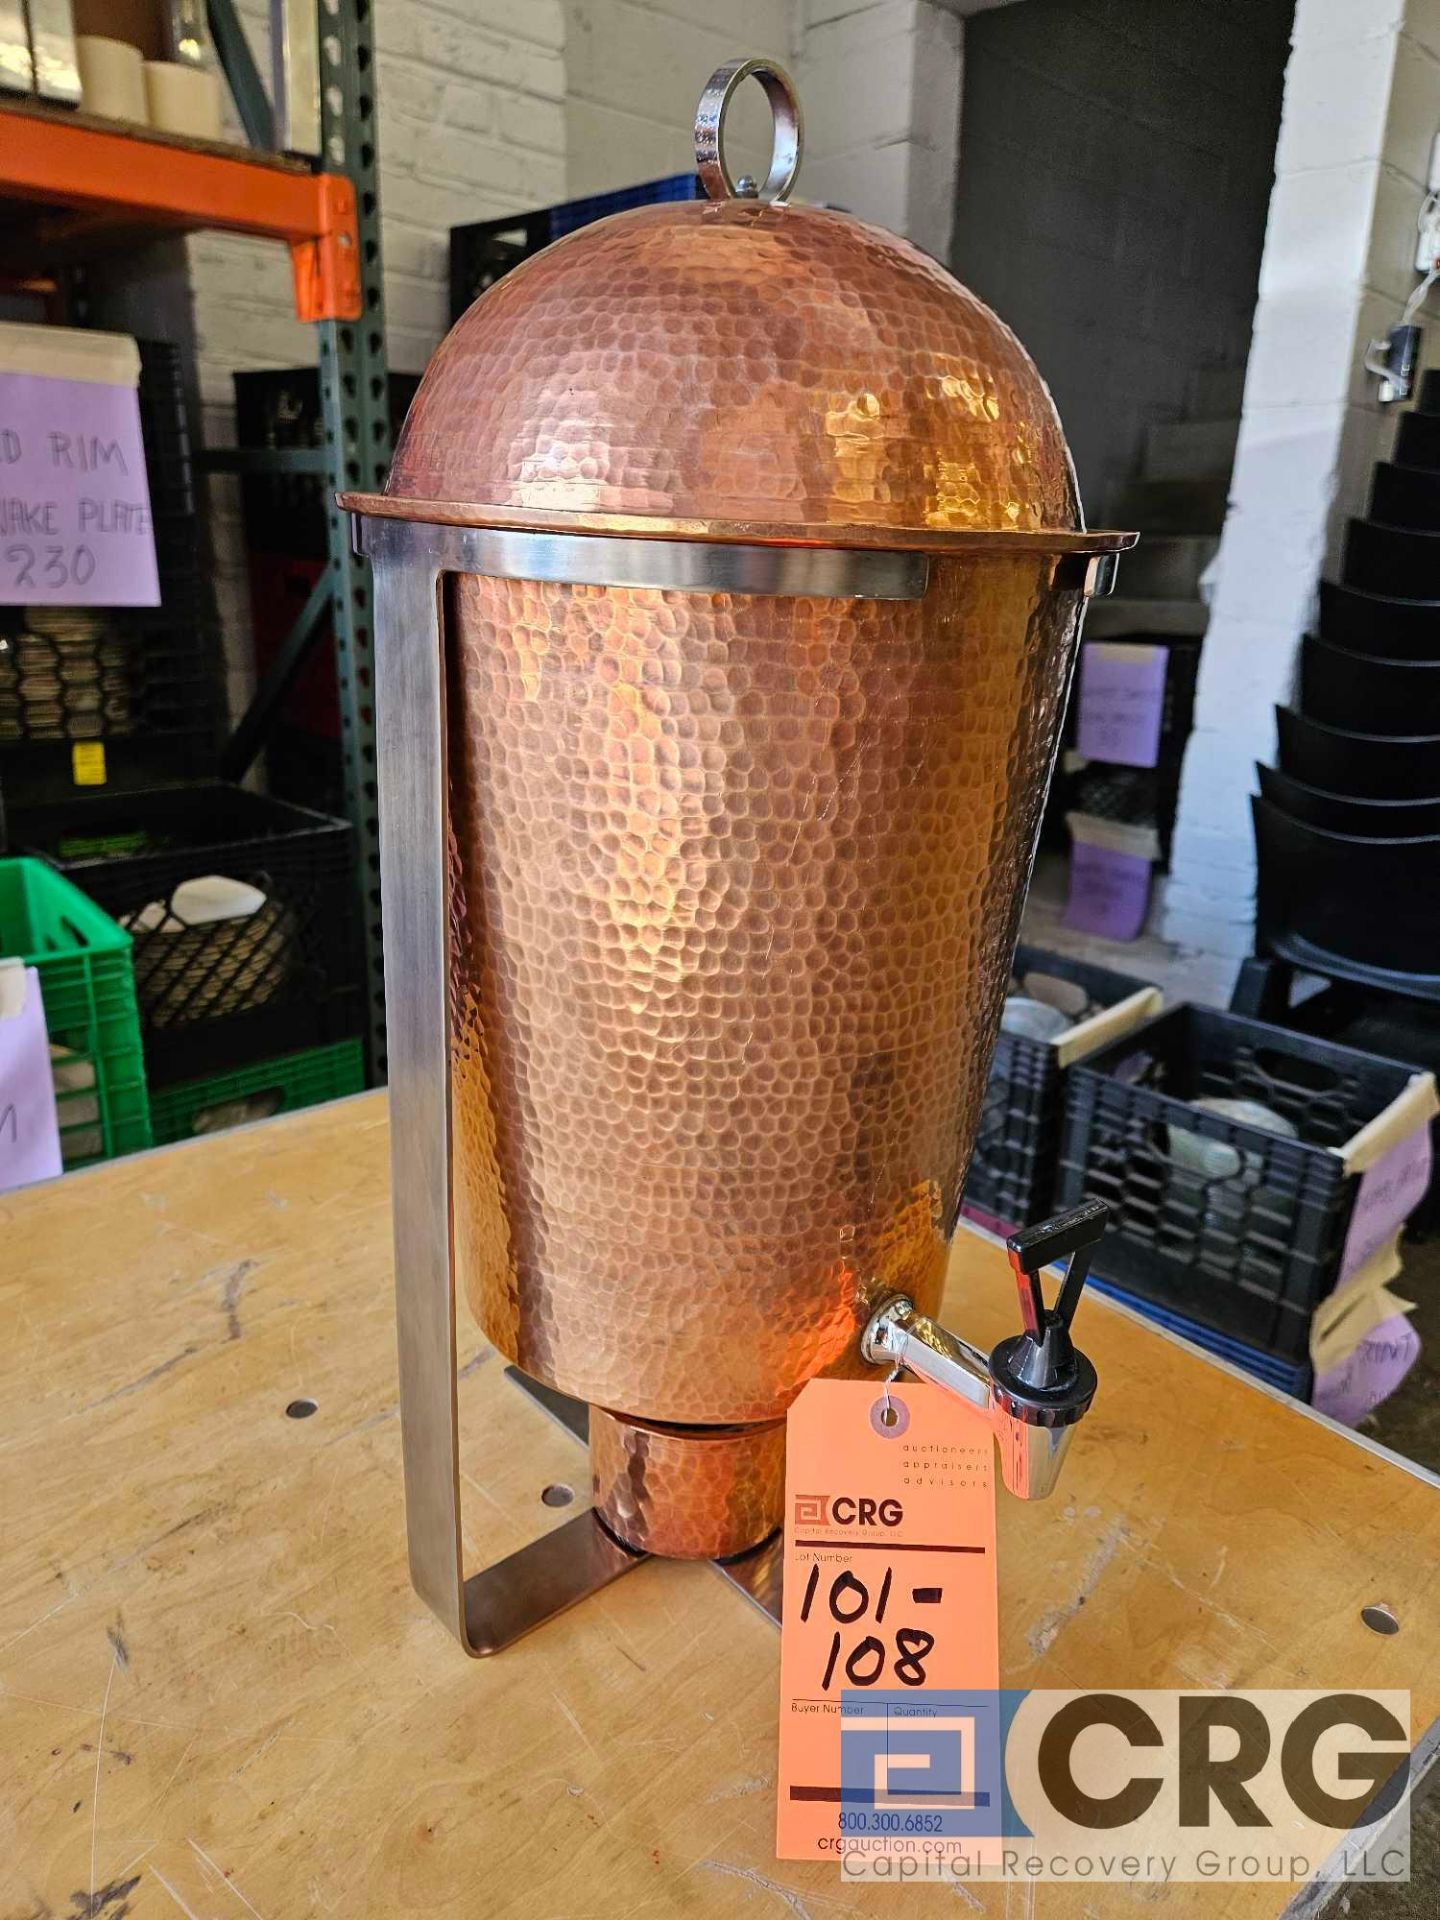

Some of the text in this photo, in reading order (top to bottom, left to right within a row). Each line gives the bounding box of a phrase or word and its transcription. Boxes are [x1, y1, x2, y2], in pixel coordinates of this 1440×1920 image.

[46, 431, 129, 477] RIM
[78, 497, 151, 536] PLATE
[5, 543, 97, 589] 230
[902, 1444, 988, 1454] auctioneers
[902, 1461, 988, 1471] appraisers
[903, 1477, 988, 1488] advisors
[831, 1497, 904, 1527] CRG
[813, 1552, 853, 1563] Number
[821, 1628, 935, 1691] 108
[791, 1702, 938, 1718] Buyer Number Quantity
[838, 1811, 943, 1833] 800.300.6852
[817, 1835, 962, 1855] crgauction.com
